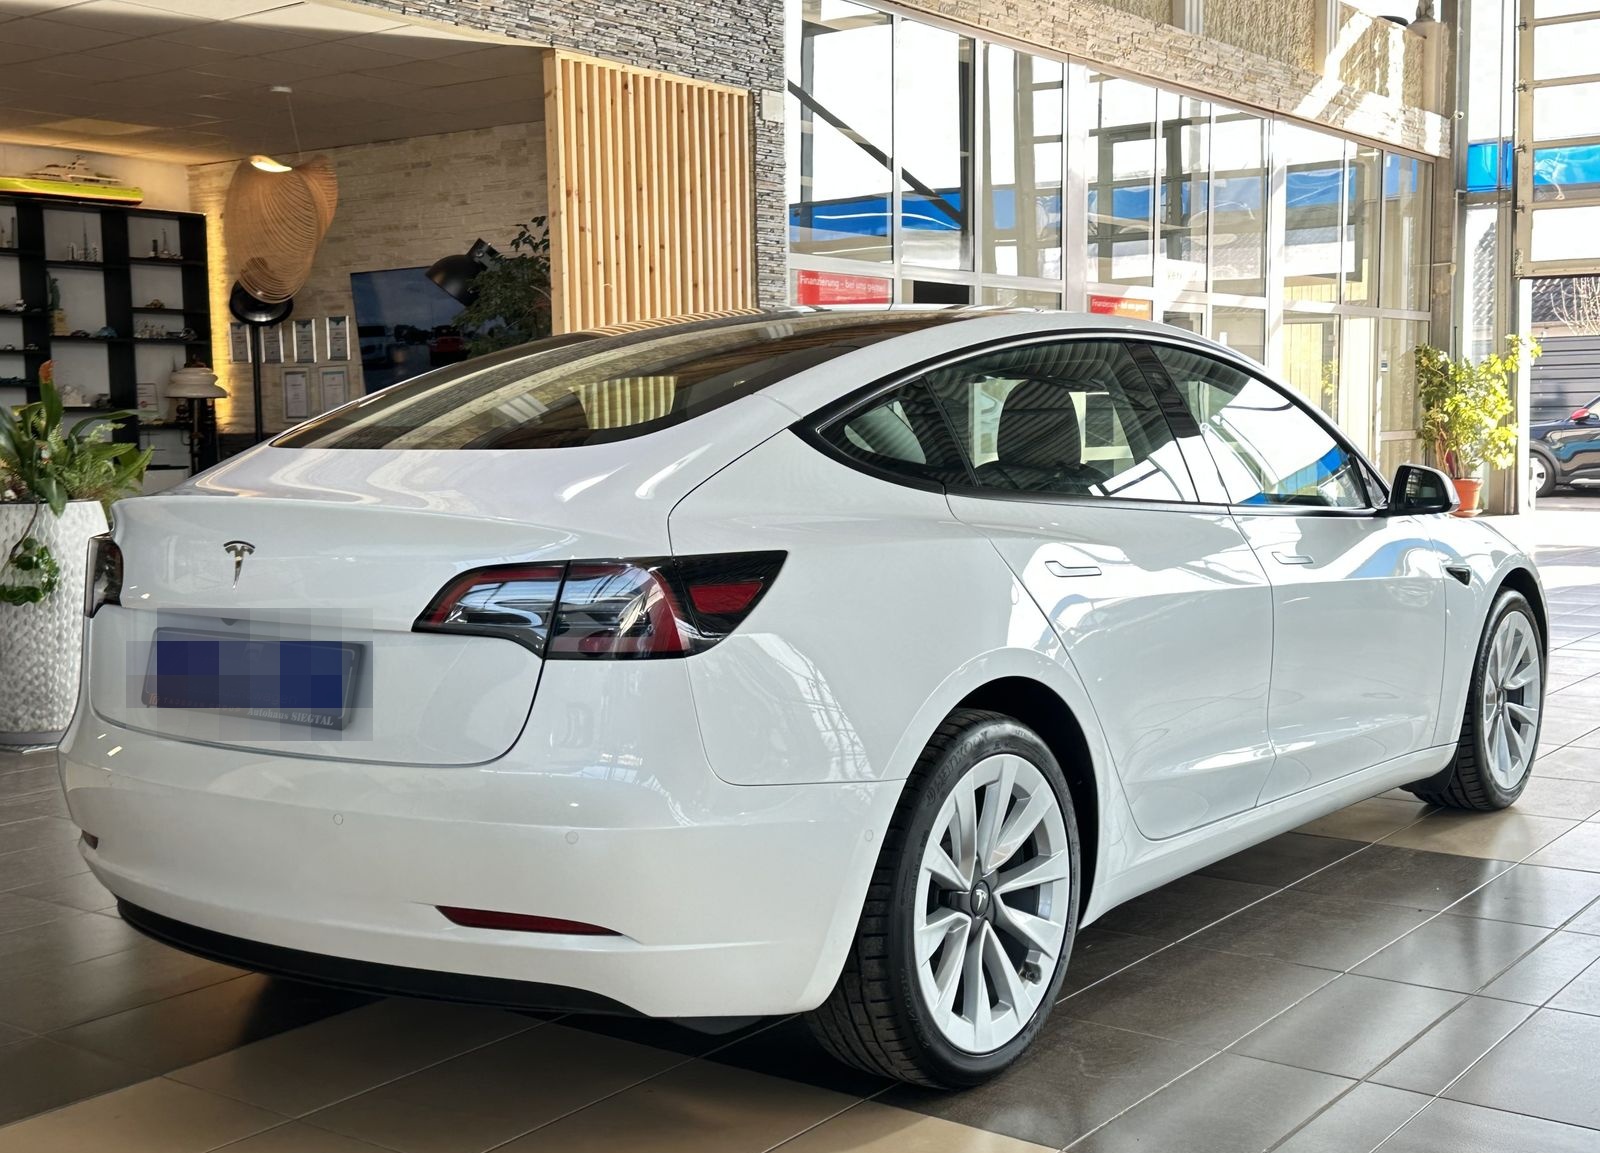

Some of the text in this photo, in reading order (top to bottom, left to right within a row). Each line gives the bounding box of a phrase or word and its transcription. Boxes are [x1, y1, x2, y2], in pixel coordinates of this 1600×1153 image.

[799, 275, 840, 289] Finanzierung
[247, 707, 289, 721] Autohaus
[290, 711, 334, 726] SIEGTAL
